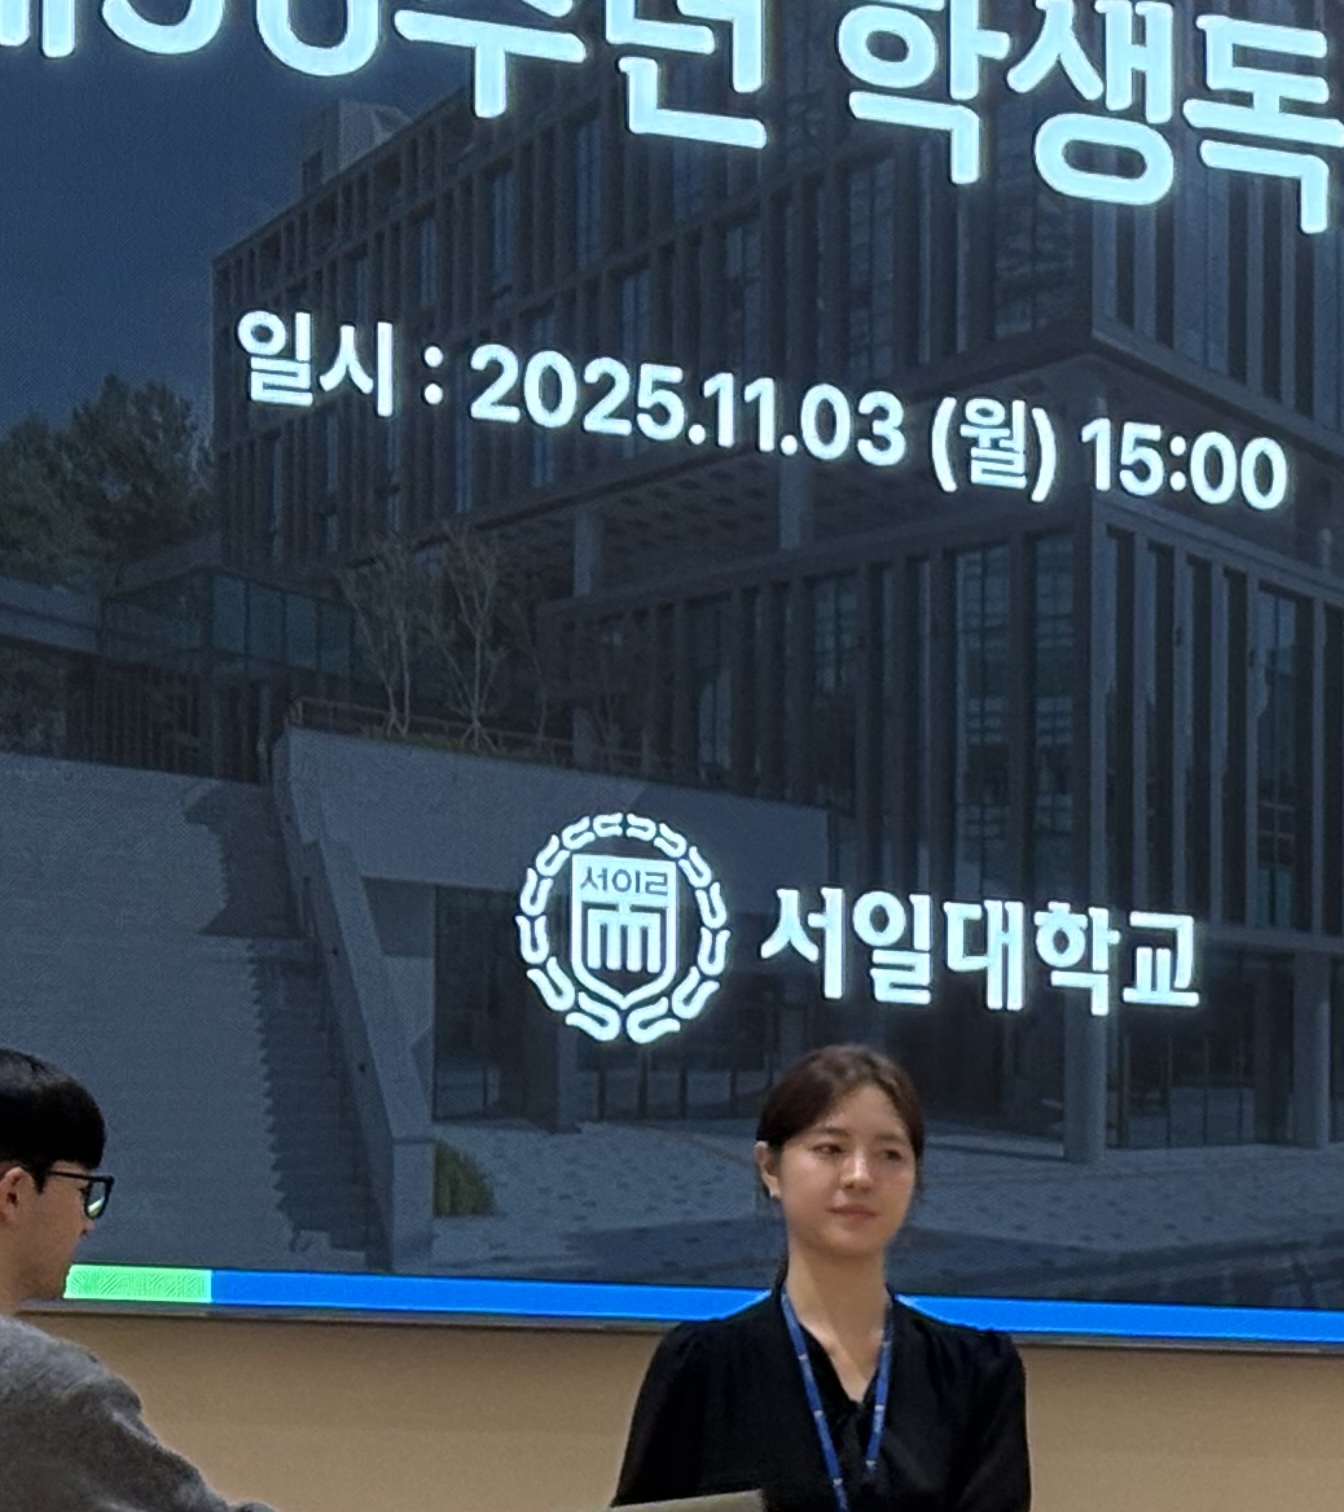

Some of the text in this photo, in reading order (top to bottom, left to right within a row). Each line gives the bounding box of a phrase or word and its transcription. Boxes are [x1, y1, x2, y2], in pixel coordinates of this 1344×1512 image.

[237, 310, 394, 418] 일시
[470, 343, 907, 467] 2025.11.03
[931, 396, 1058, 503] (월)
[1081, 417, 1289, 510] 15:00
[760, 886, 1200, 1017] 서일대학교
